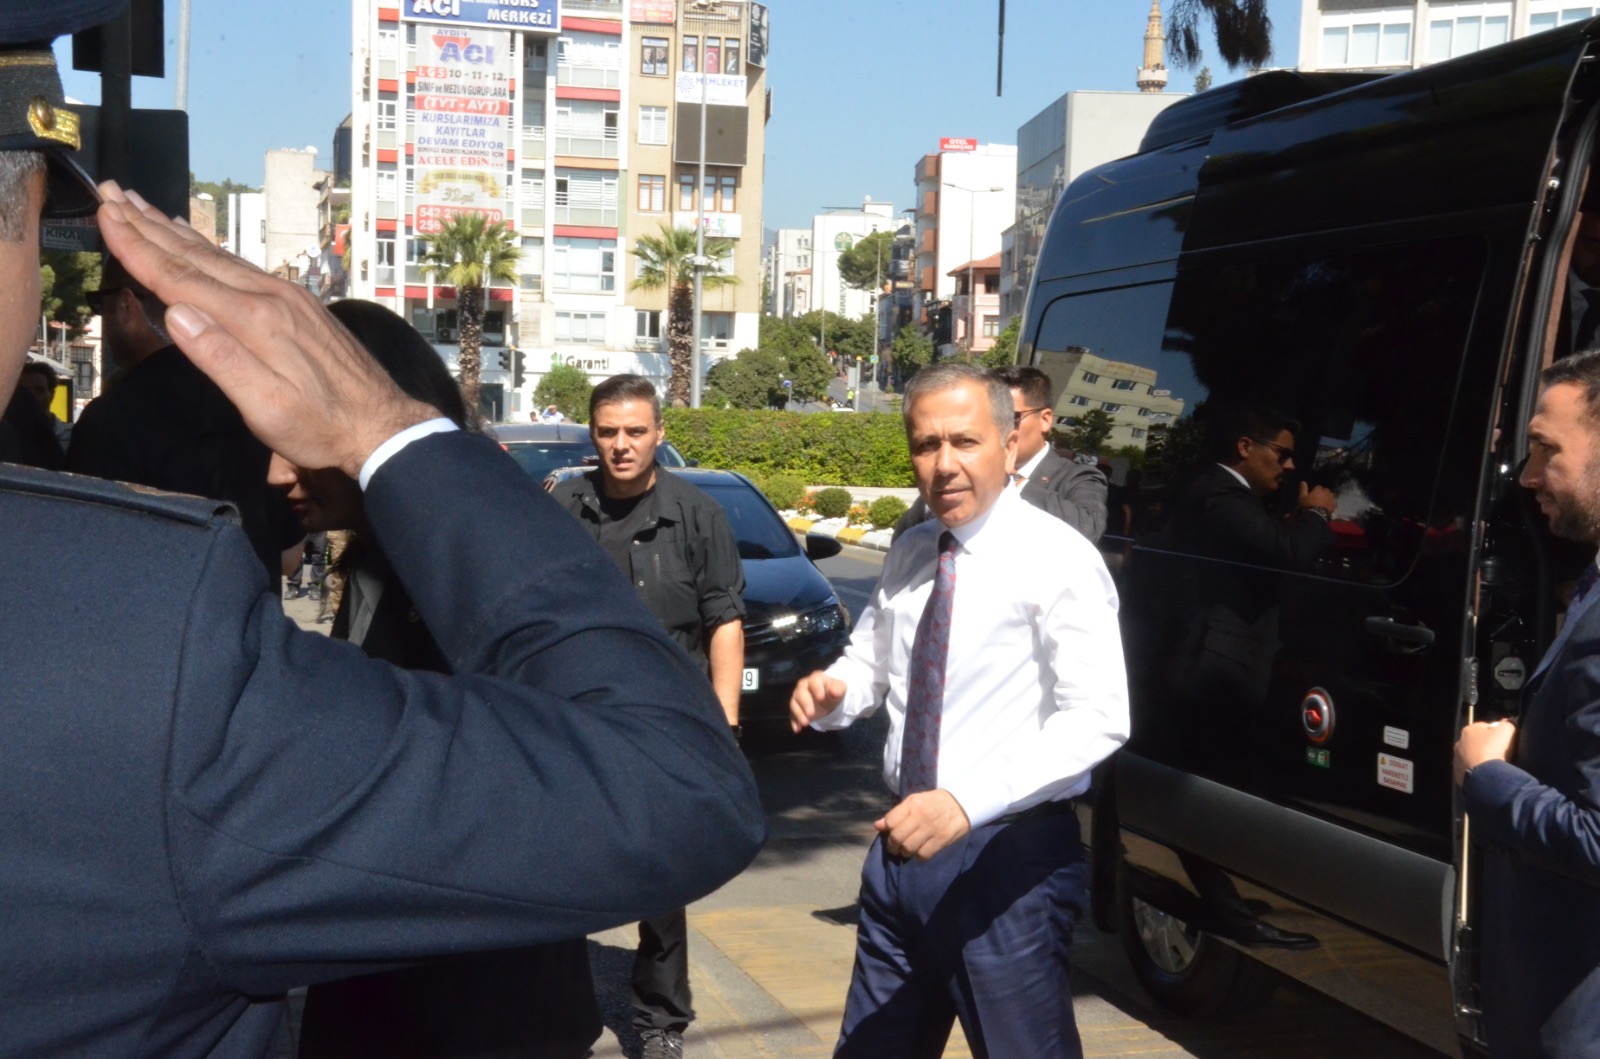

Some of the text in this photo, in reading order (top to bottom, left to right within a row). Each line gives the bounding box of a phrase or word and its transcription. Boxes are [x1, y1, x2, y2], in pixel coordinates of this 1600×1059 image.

[413, 0, 460, 17] AÇI
[487, 9, 552, 26] MERKEZİ
[437, 29, 467, 38] AYDIN
[440, 42, 494, 65] AÇI
[449, 69, 462, 78] 10
[472, 71, 482, 79] 11
[418, 82, 434, 92] SINIF
[443, 83, 466, 95] MEZUN
[467, 85, 507, 98] GURUPLARA
[696, 77, 745, 88] MEMLEKET
[424, 96, 458, 110] (TYT
[467, 98, 500, 114] AYT)
[422, 112, 500, 127] KURSLARIMIZA
[436, 126, 486, 138] KAYITLAR
[418, 136, 459, 147] DEVAM
[418, 156, 457, 166] ACELE
[566, 355, 609, 371] Garanti
